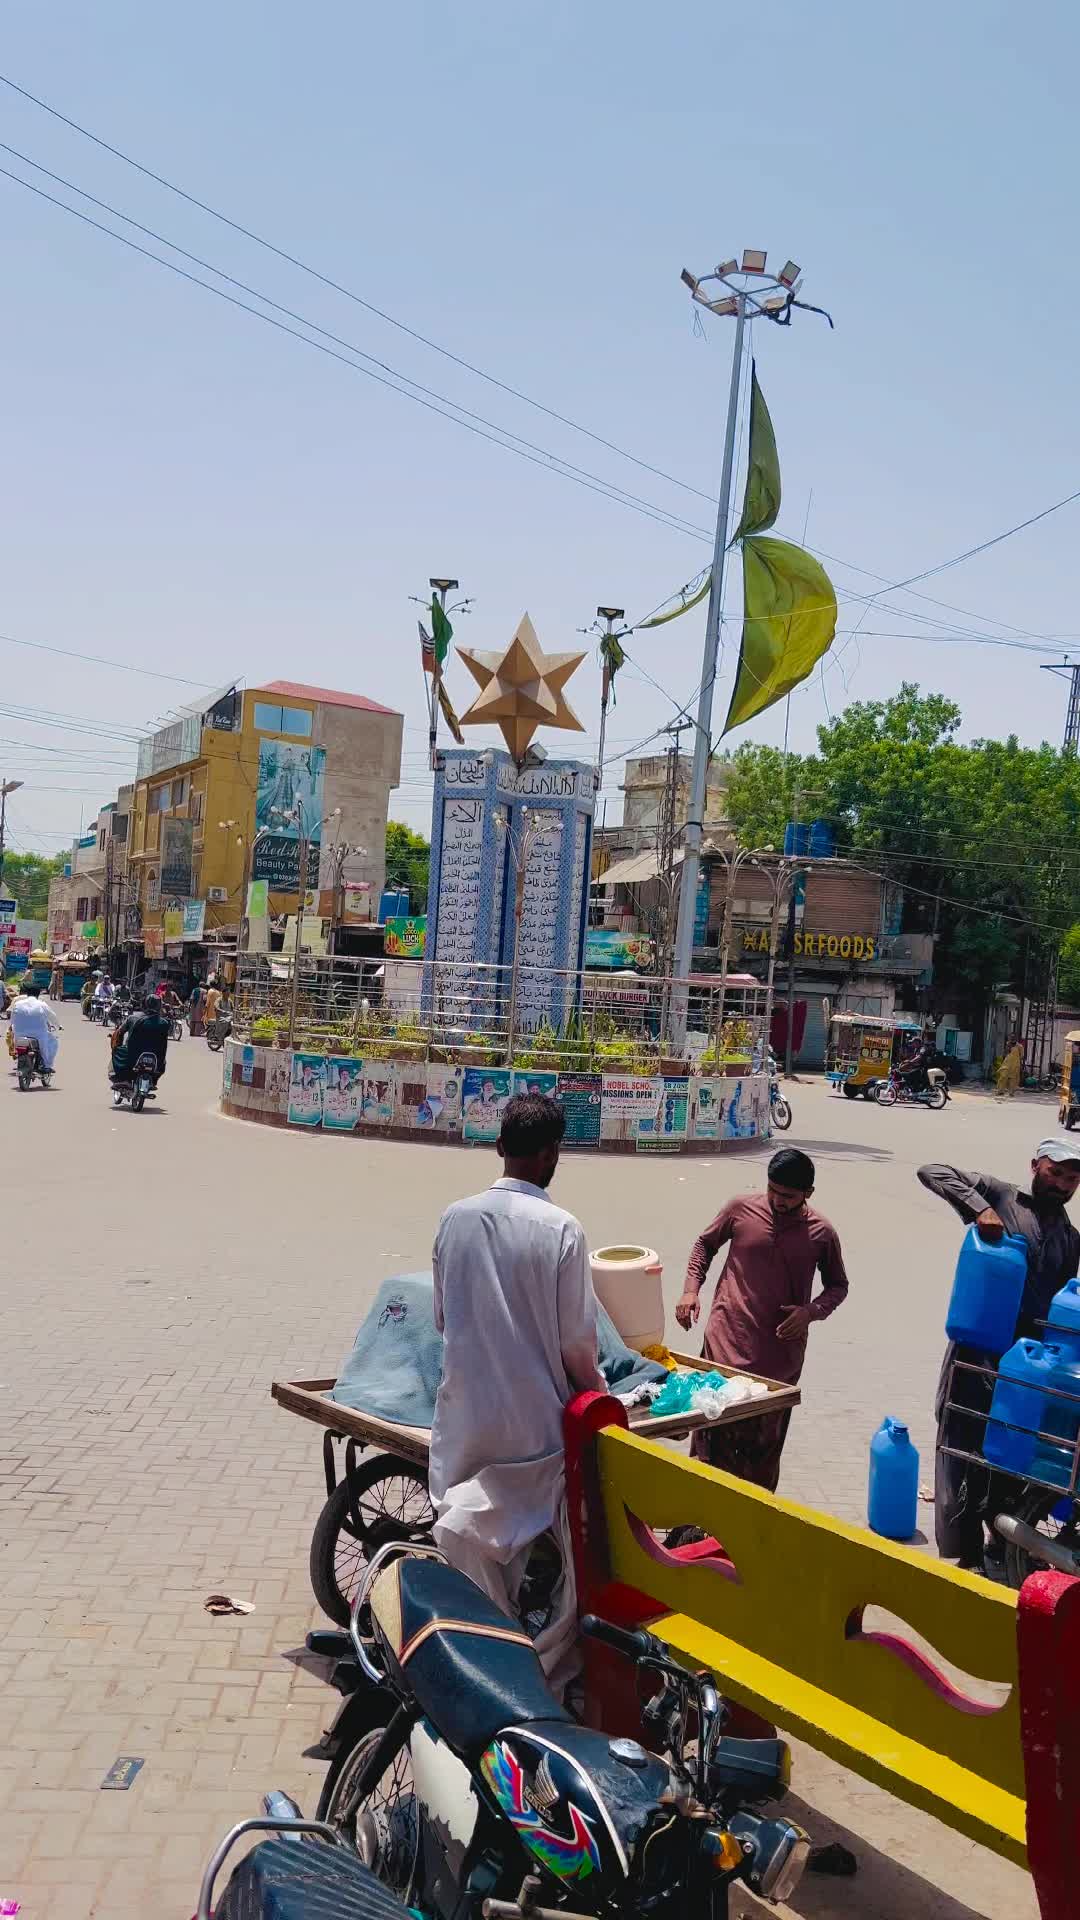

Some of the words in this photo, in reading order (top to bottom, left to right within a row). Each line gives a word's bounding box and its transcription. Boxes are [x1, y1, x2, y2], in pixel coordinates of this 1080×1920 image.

[288, 844, 318, 859] Re
[256, 858, 286, 871] Beauty
[402, 934, 419, 943] LUCK
[619, 992, 648, 1002] BURGER
[606, 1081, 630, 1089] NOBEL
[312, 1092, 319, 1101] 13
[636, 1090, 652, 1100] OPEN
[350, 1097, 357, 1106] 13
